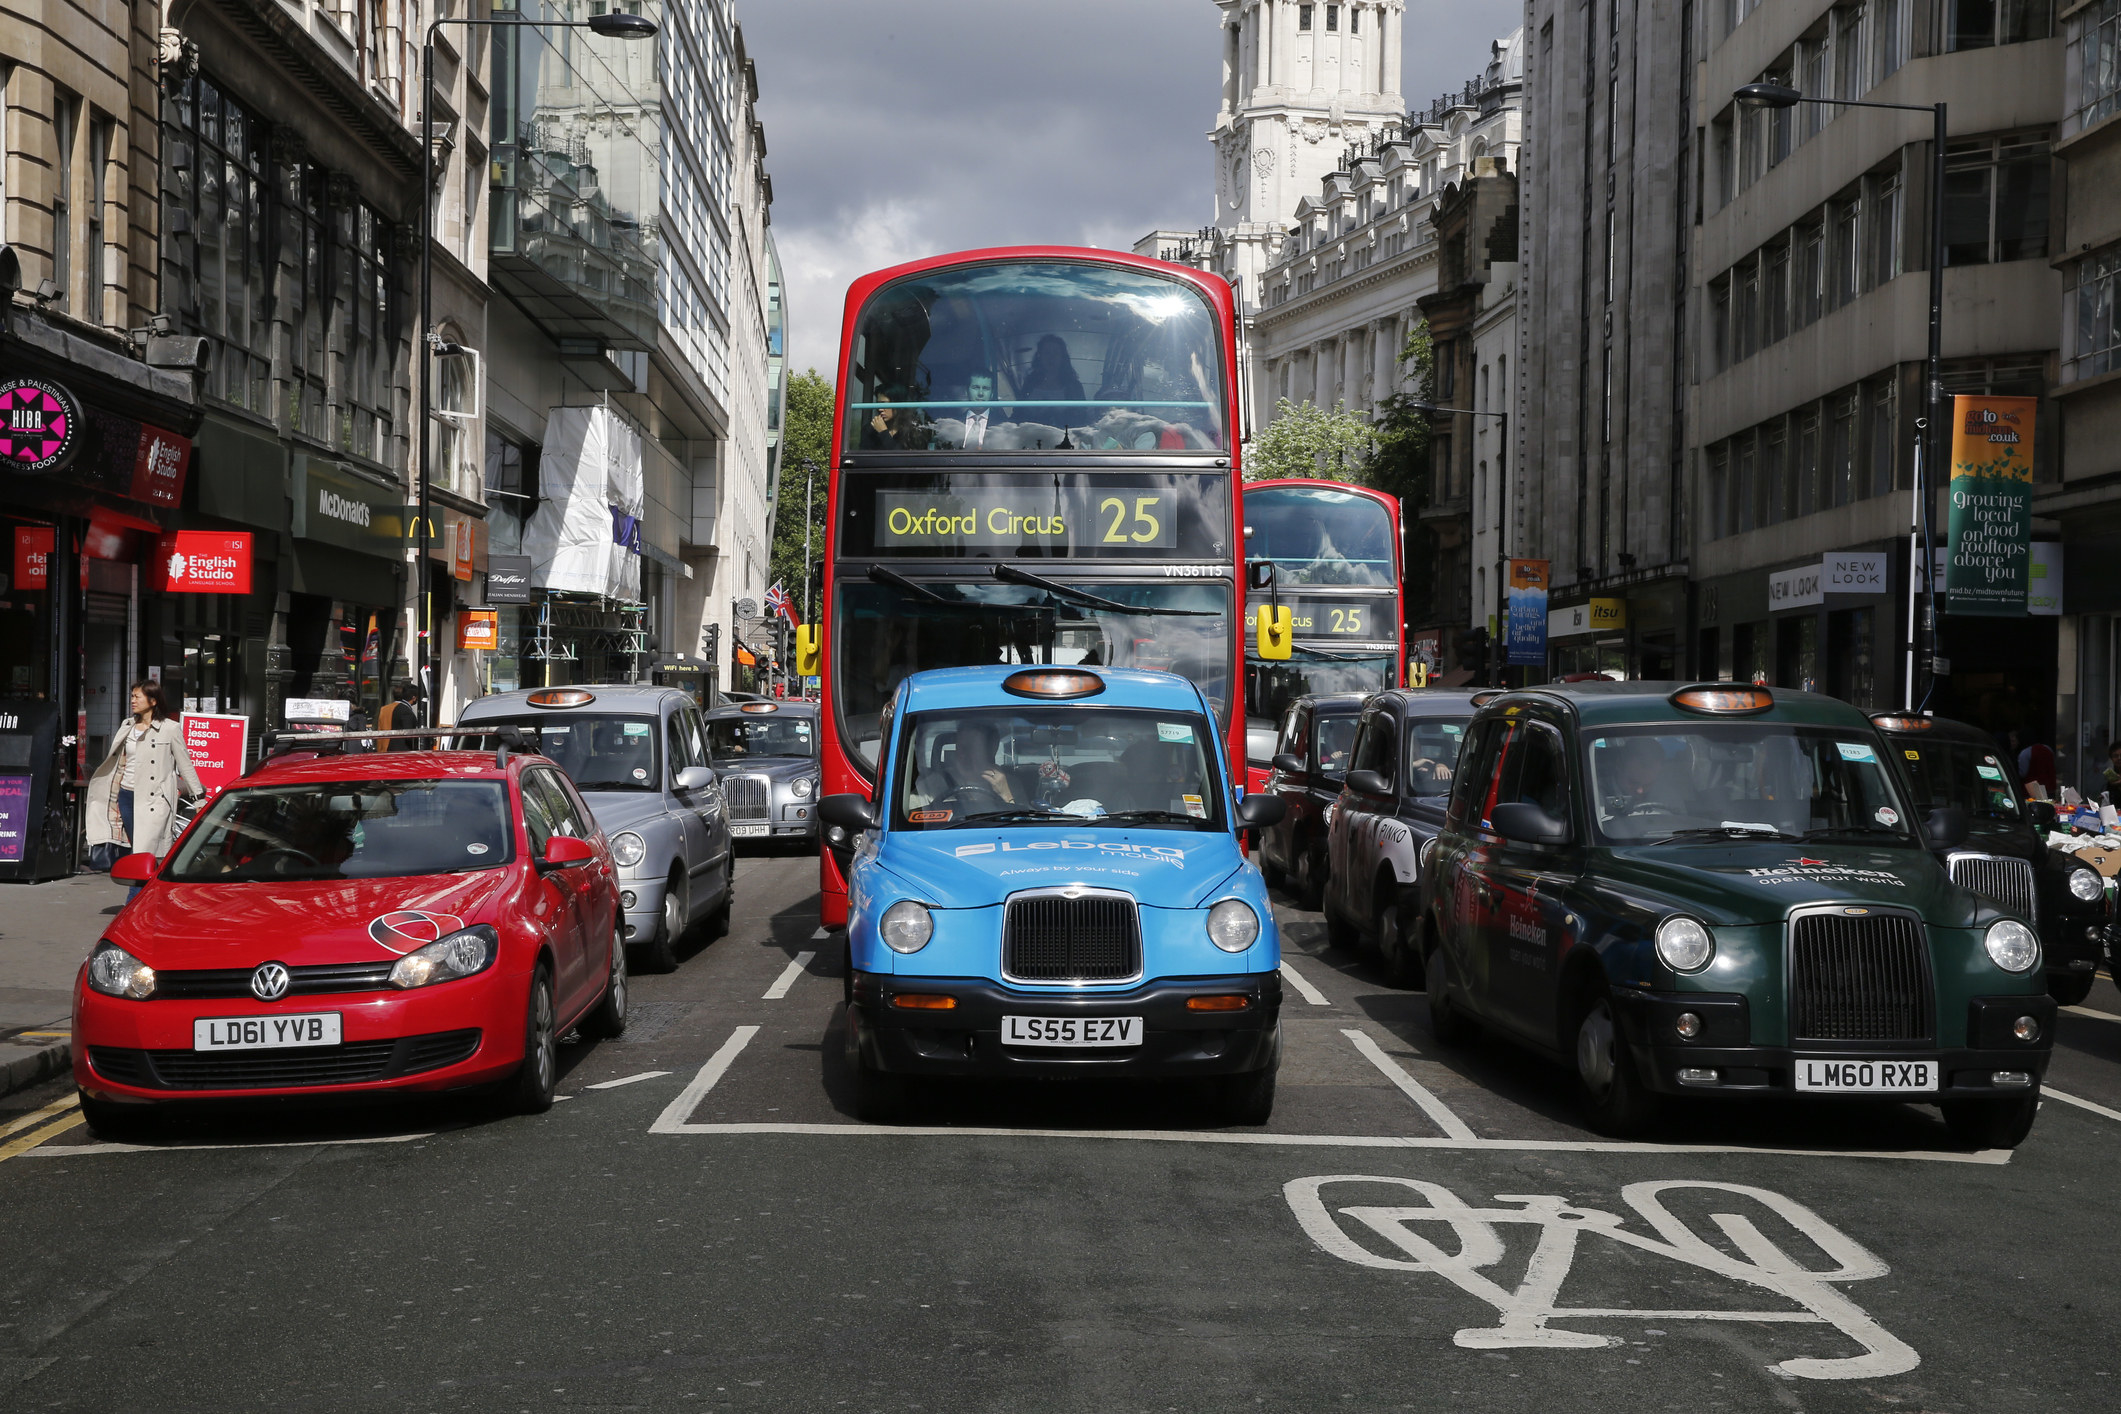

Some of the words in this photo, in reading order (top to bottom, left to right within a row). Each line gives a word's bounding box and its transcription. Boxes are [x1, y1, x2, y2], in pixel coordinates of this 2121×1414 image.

[0, 381, 17, 394] NESE
[19, 379, 26, 387] &
[27, 380, 71, 413] PALESTINIAN
[160, 441, 181, 463] English
[0, 452, 31, 470] XPRESS
[32, 455, 57, 470] FOOD
[156, 459, 177, 479] Studio
[319, 489, 370, 527] McDonald's
[1973, 506, 2012, 522] local
[888, 506, 976, 535] Oxford
[987, 507, 1064, 535] Circus
[1100, 497, 1160, 543] 25
[1962, 530, 1983, 541] on
[1984, 522, 2019, 537] food
[231, 541, 243, 549] ISI
[1961, 538, 2026, 558] rooftops
[189, 555, 237, 570] English
[1836, 561, 1876, 571] NEW
[1954, 552, 2004, 567] above
[189, 567, 234, 579] Studio
[1164, 566, 1223, 577] VN36115
[1832, 574, 1880, 584] LOOK
[1985, 567, 2015, 583] you
[1769, 583, 1790, 600] NEW
[1793, 575, 1819, 597] LOOK
[1949, 587, 2025, 597] mid.bz/midtownfuture
[1593, 605, 1619, 618] itsu
[1291, 616, 1313, 627] cus
[1330, 608, 1362, 633] 25
[1706, 692, 1757, 708] AXI
[188, 720, 210, 729] First
[187, 729, 220, 738] lesson
[187, 738, 208, 747] free
[190, 760, 225, 768] nternet
[748, 825, 766, 834] UHH
[1381, 824, 1407, 843] PINKO
[1002, 840, 1185, 860] Lebara
[1101, 850, 1185, 870] mobile
[1000, 865, 1050, 877] Always
[1111, 868, 1140, 877] side
[1745, 866, 1899, 879] Heineken
[1759, 875, 1806, 885] open
[1854, 876, 1906, 887] world
[1509, 914, 1547, 947] Heineken
[210, 1022, 265, 1046] LD61
[273, 1018, 323, 1042] YVB
[1011, 1020, 1076, 1041] LS55
[1083, 1020, 1131, 1041] EZV
[1807, 1063, 1874, 1088] LM60
[1881, 1063, 1928, 1088] RXB
